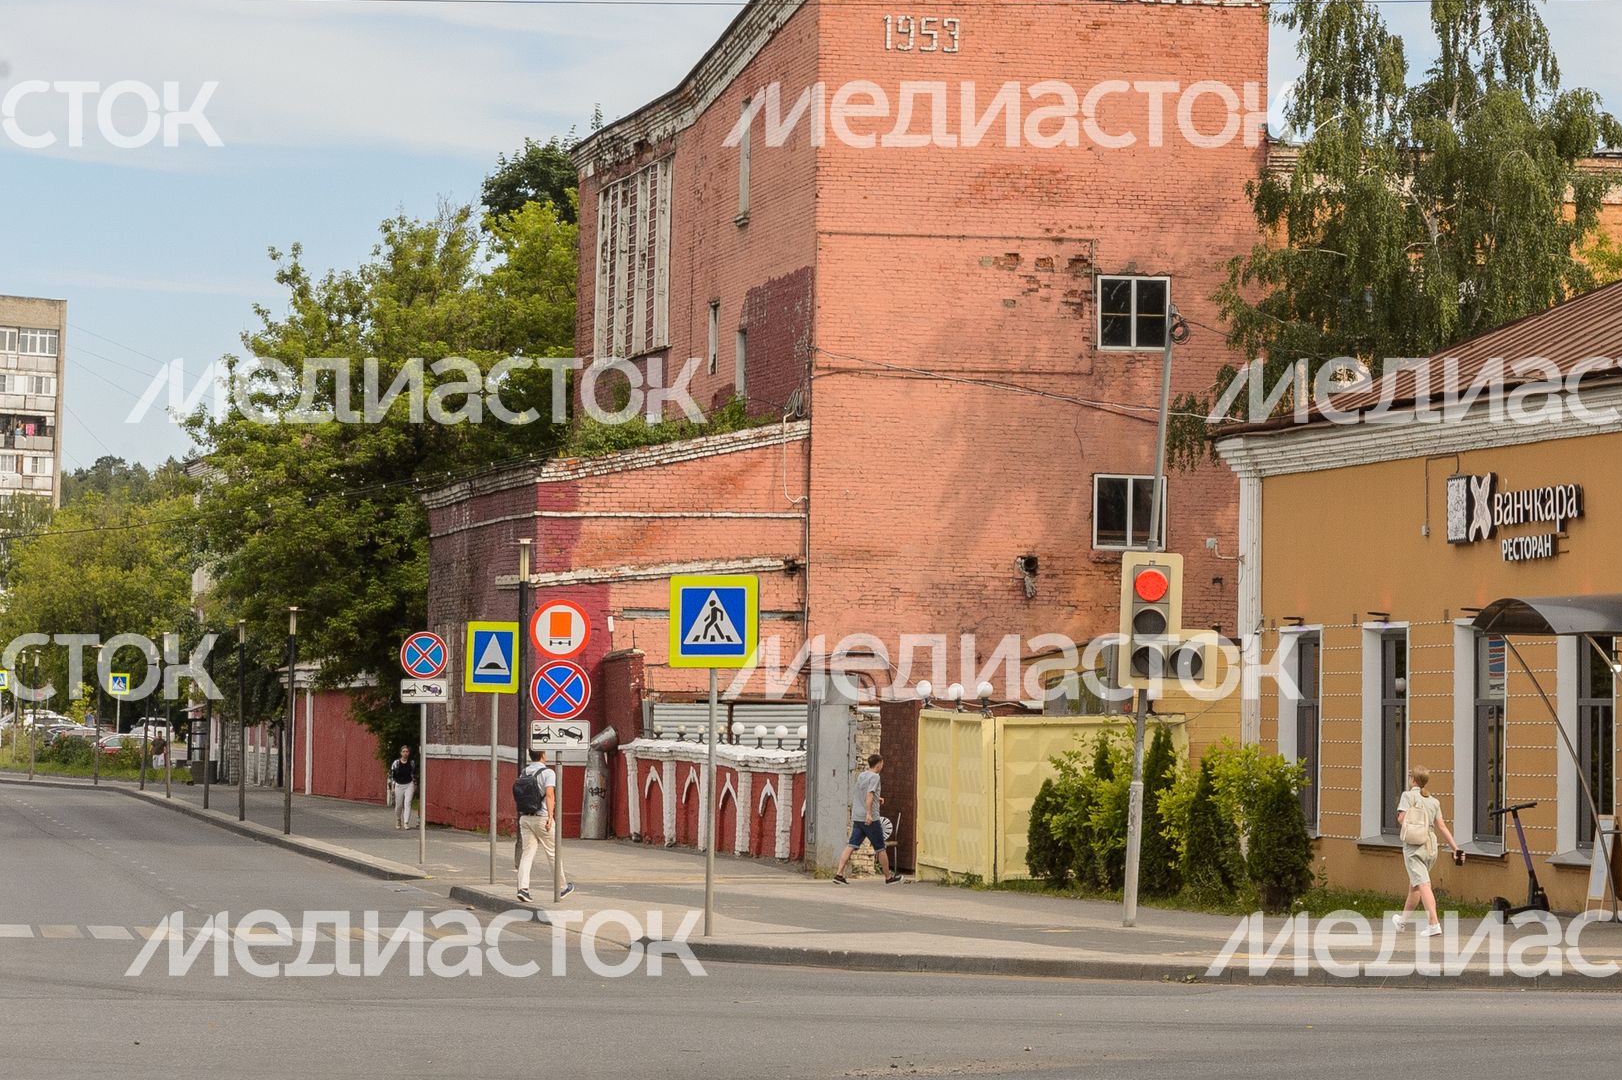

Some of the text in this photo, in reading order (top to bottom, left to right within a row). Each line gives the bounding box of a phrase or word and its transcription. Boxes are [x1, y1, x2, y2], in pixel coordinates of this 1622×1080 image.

[883, 15, 960, 52] 1953
[1469, 472, 1578, 542] Хванчкара
[1502, 533, 1552, 561] РЕСТОРАН
